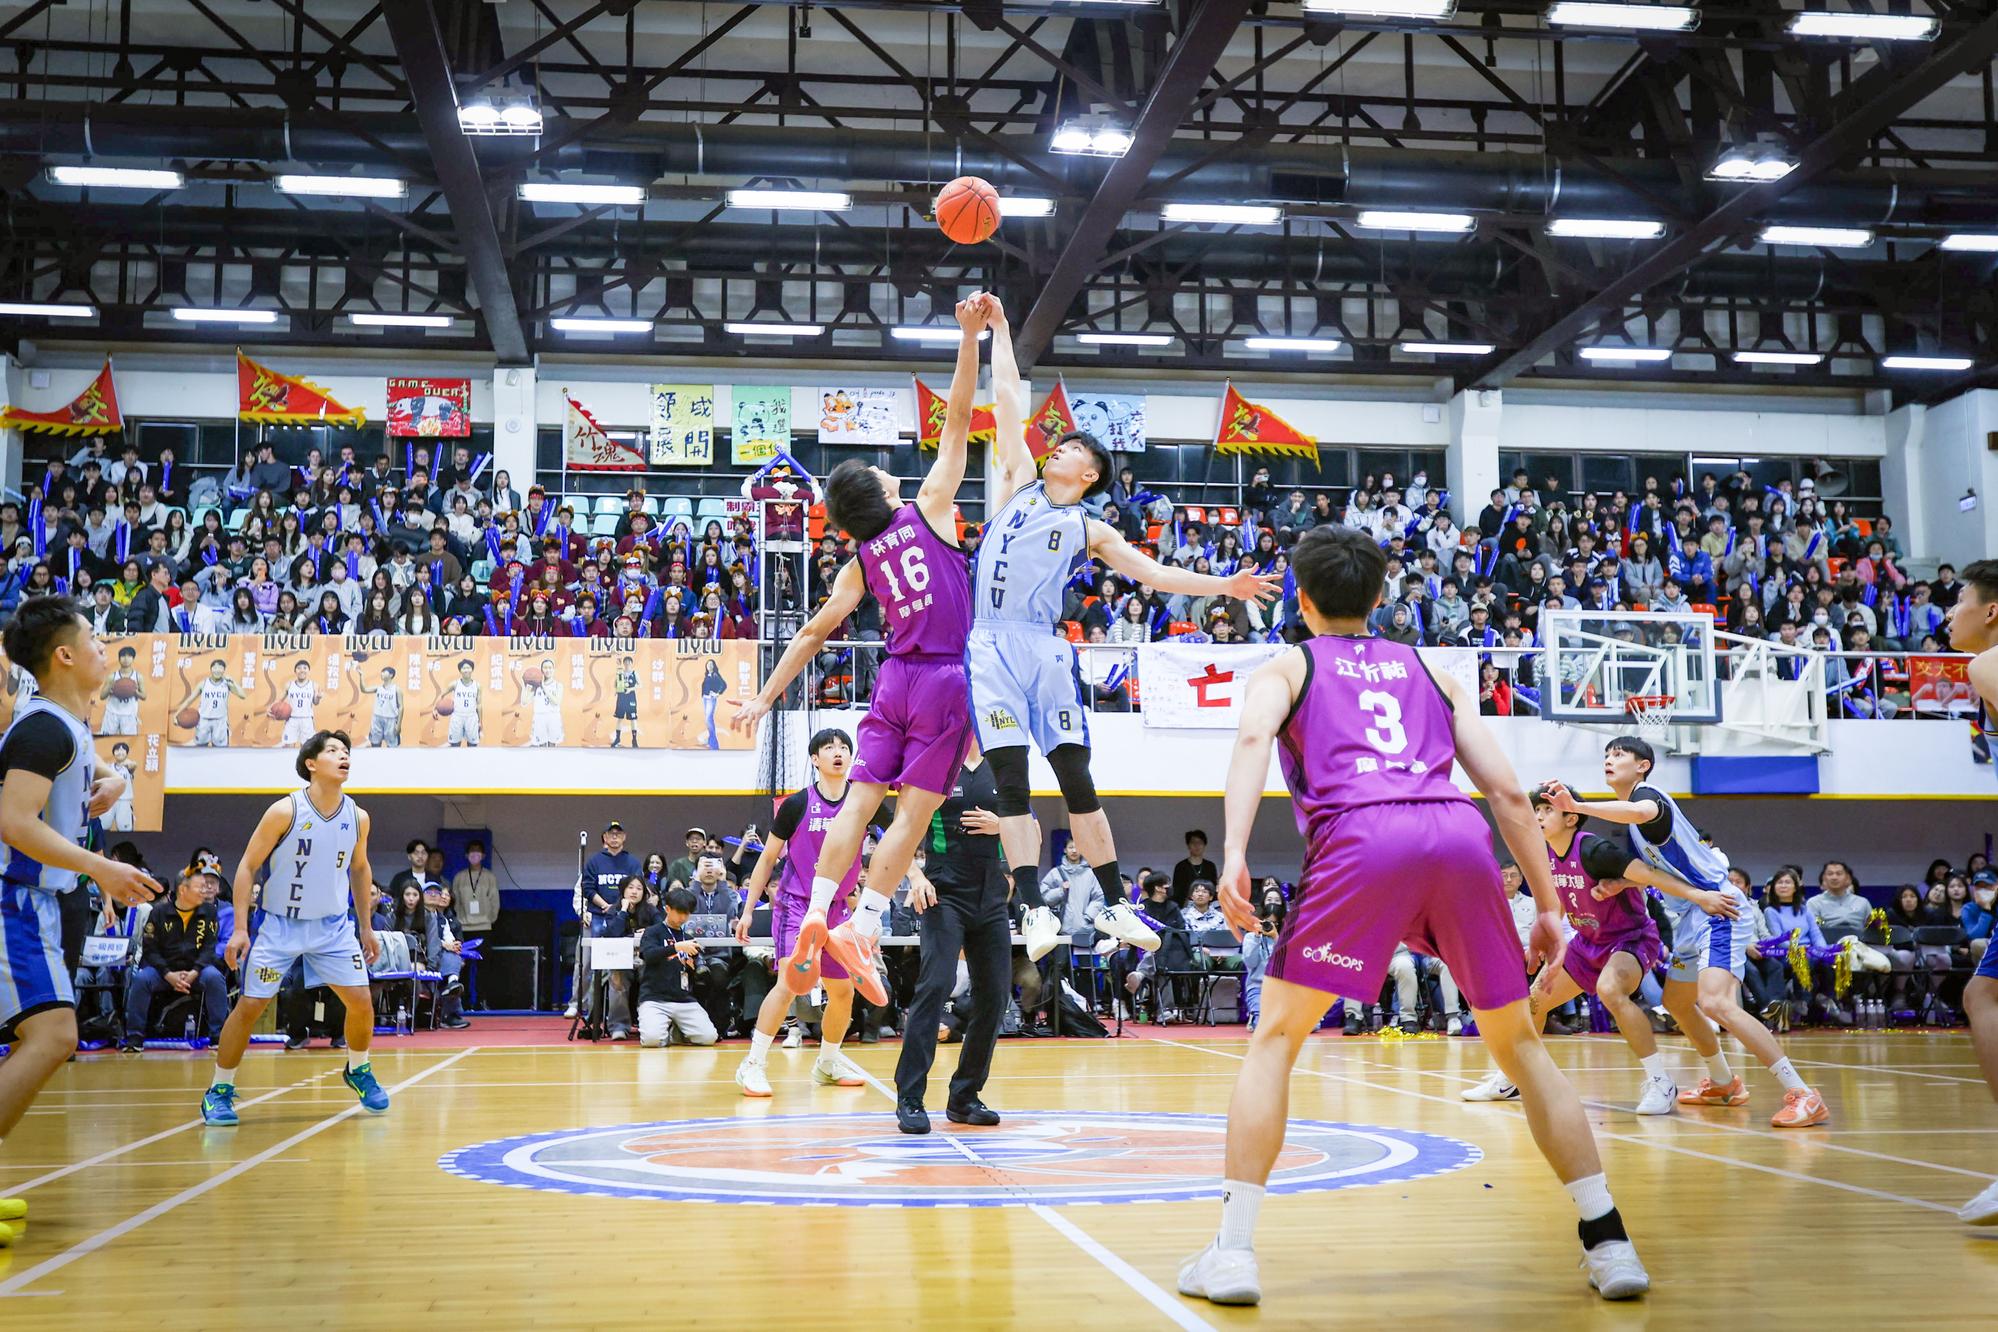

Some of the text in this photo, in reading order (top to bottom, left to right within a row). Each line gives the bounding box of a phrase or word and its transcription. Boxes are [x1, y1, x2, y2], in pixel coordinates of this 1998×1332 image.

[574, 426, 626, 464] 竹魂
[739, 443, 777, 457] 一個
[869, 524, 916, 557] 林育同
[1047, 530, 1062, 552] 8
[991, 509, 1028, 609] NYCU
[880, 546, 930, 602] 16
[178, 633, 228, 648] NYCU
[263, 635, 312, 650] NYCU
[345, 635, 392, 650] NYCU
[427, 636, 475, 651] NYCU
[509, 636, 556, 651] NYCU
[590, 637, 636, 652] NYCU
[677, 638, 723, 654] NYCU
[1915, 661, 1968, 679] 交大不
[1187, 663, 1234, 708] 亡
[1058, 711, 1072, 731] 8
[1358, 688, 1408, 754] 3
[336, 851, 346, 869] 5
